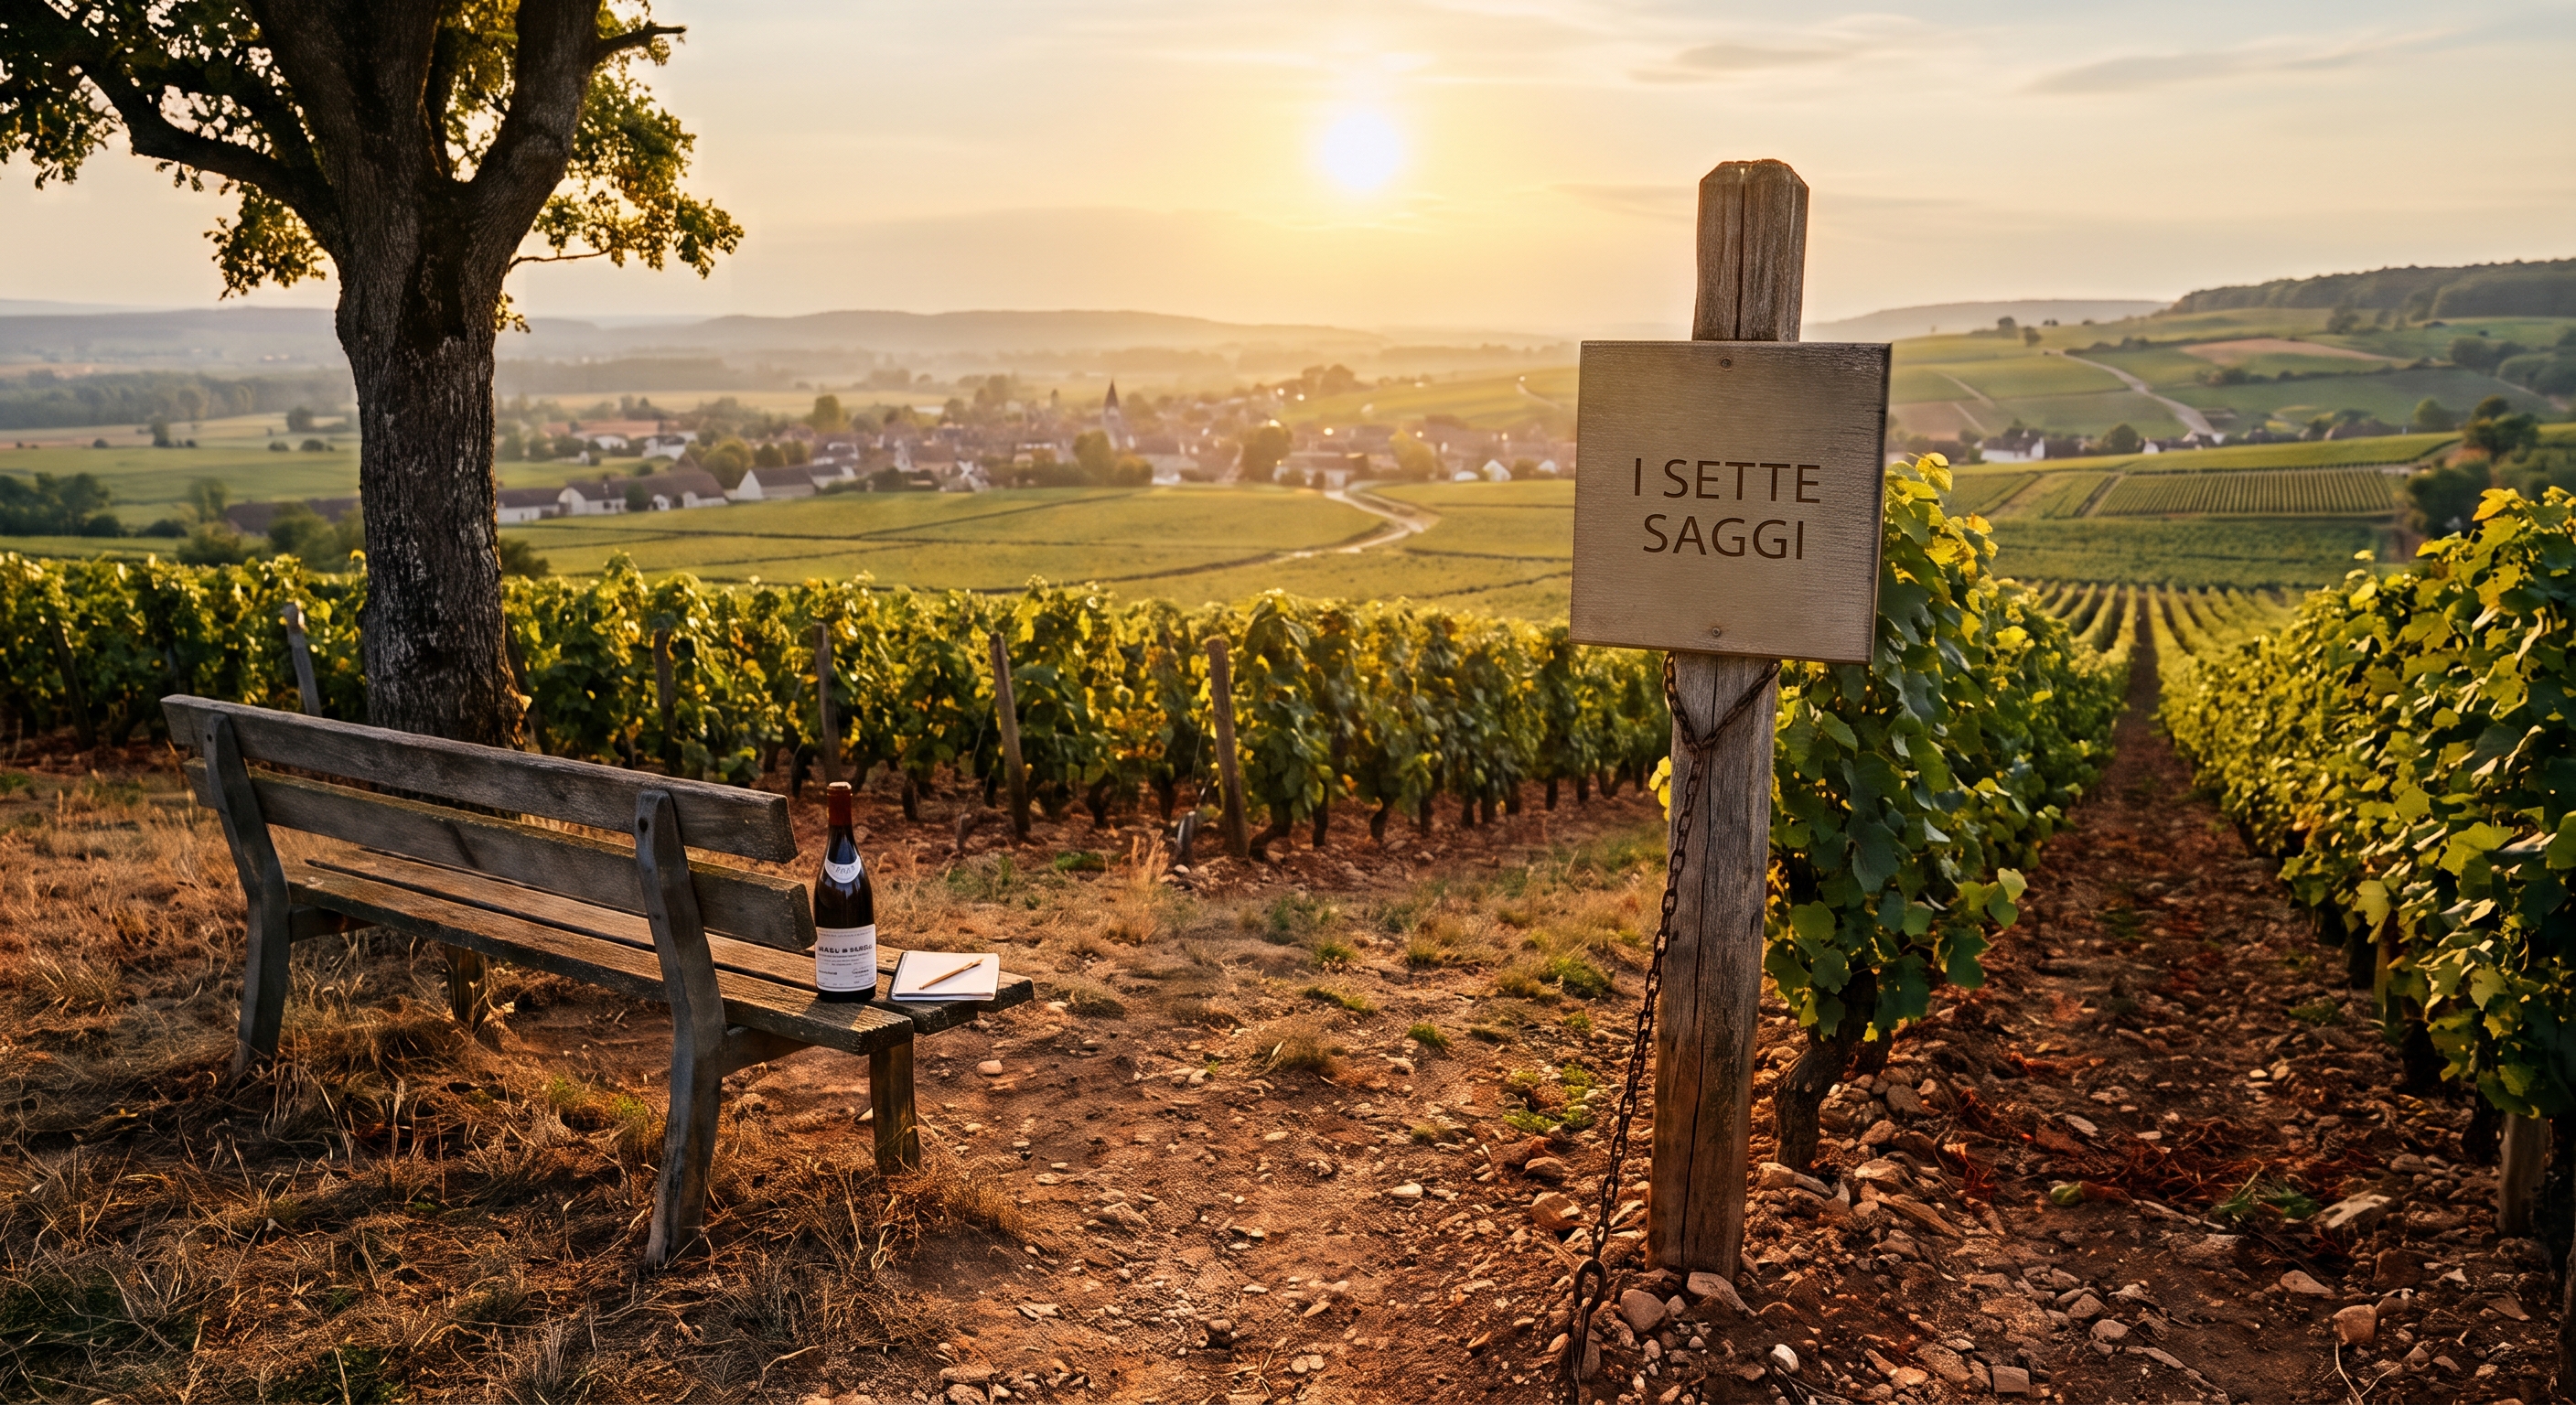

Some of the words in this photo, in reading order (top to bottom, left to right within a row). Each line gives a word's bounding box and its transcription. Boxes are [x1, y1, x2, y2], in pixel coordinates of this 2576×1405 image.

[1635, 458, 1642, 496] I
[1663, 458, 1820, 504] SETTE
[1643, 513, 1804, 560] SAGGI
